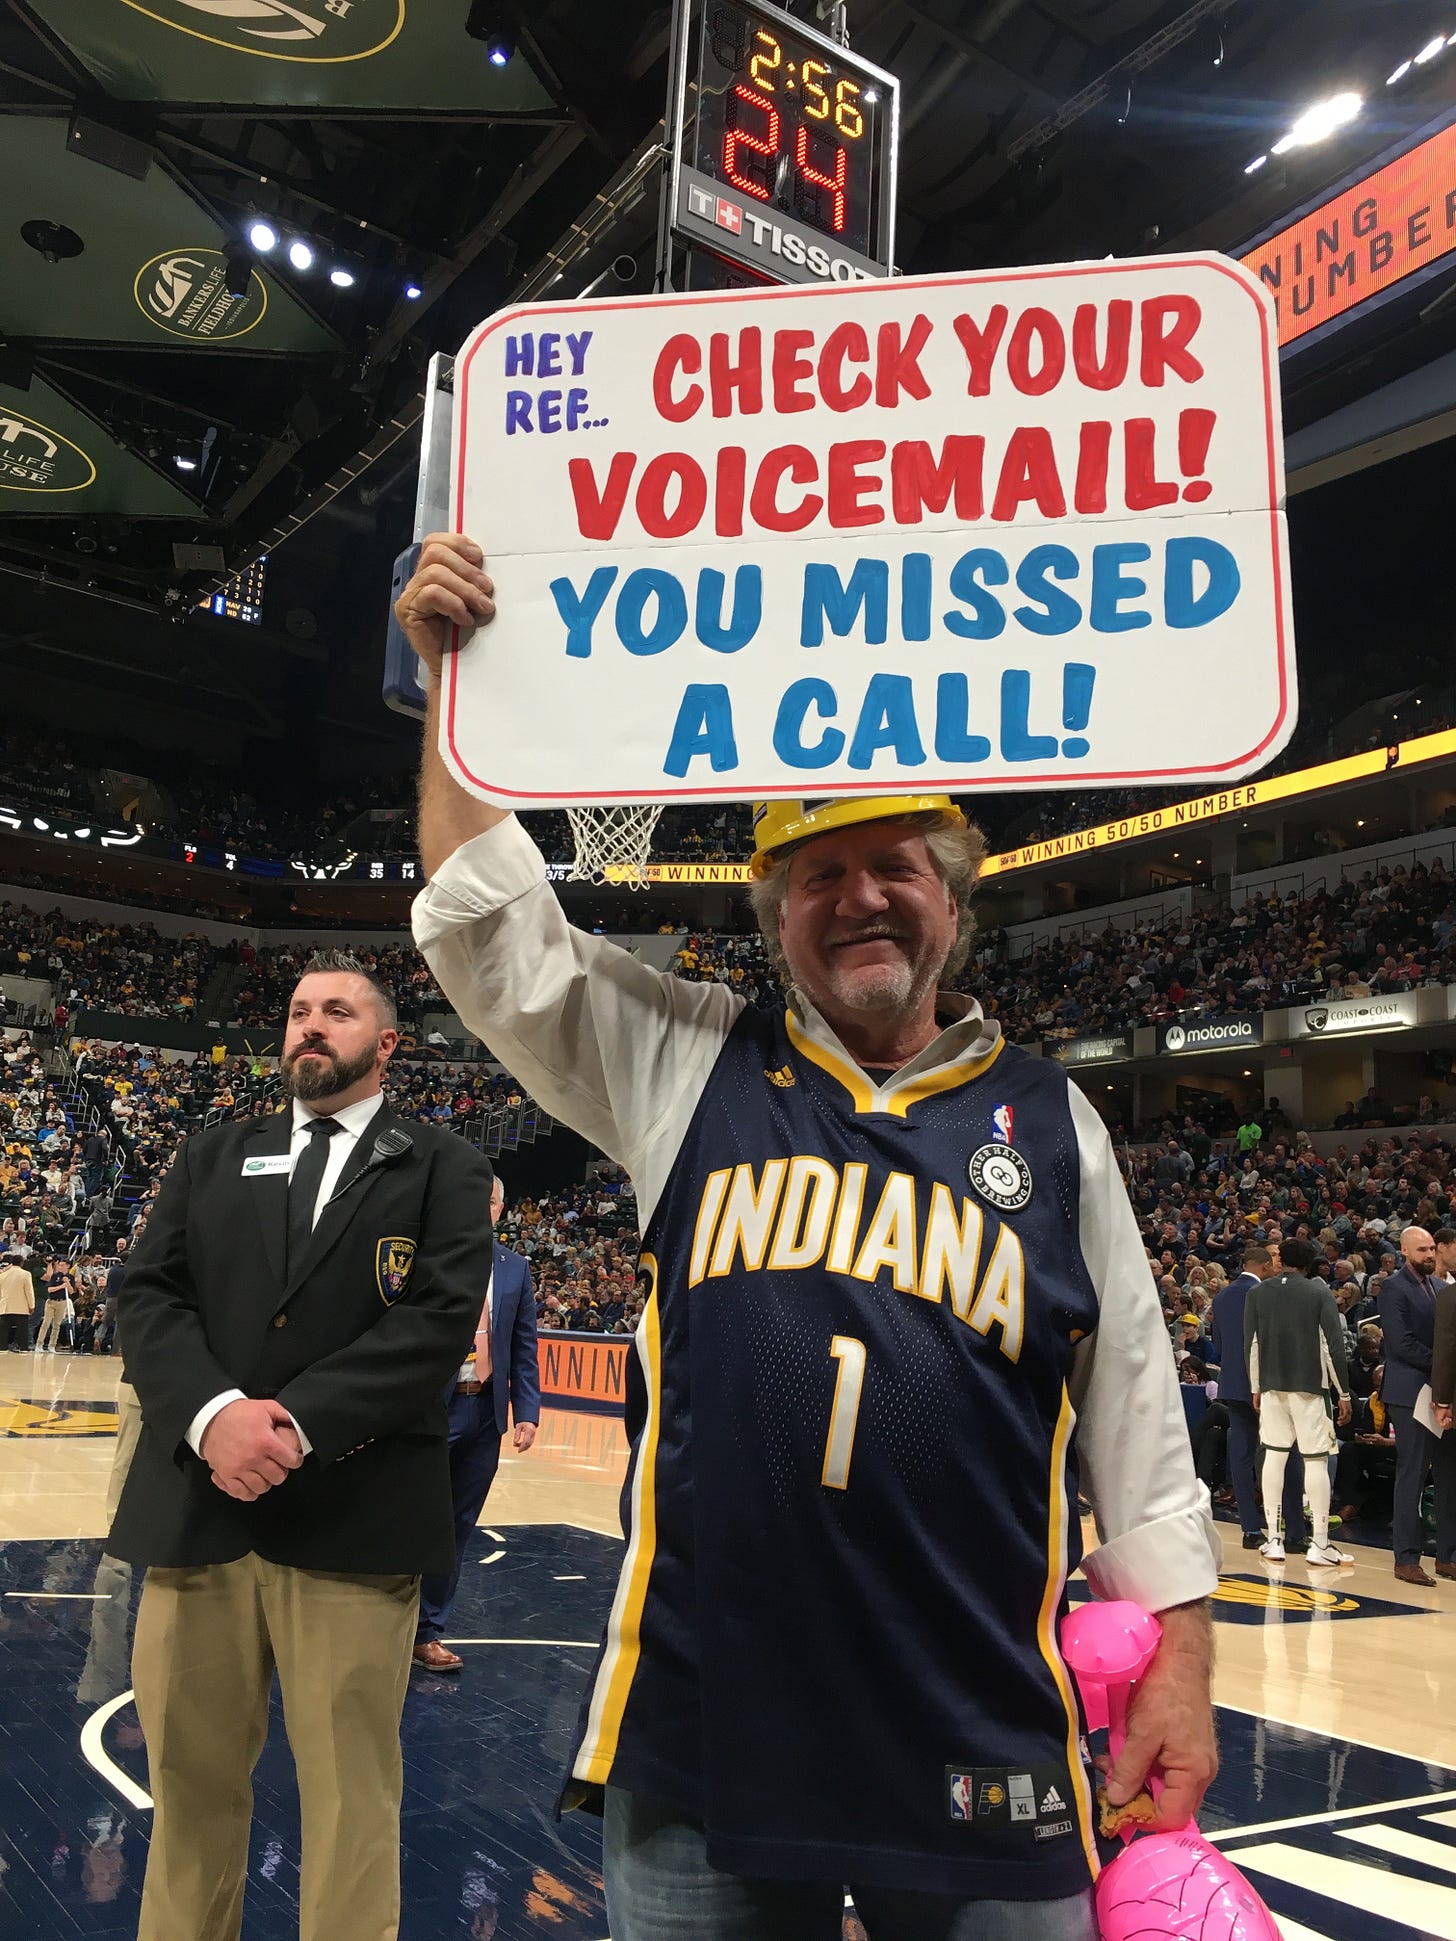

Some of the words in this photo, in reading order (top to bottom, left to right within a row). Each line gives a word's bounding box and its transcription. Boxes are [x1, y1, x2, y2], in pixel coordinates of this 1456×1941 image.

[750, 31, 864, 139] 2:56
[724, 84, 847, 232] 24
[1274, 189, 1456, 328] UMBE
[198, 288, 236, 336] FIELDHO
[505, 331, 593, 379] HEY
[653, 314, 933, 424] CHECK
[953, 294, 1204, 398] YOUR
[506, 388, 610, 436] REF...
[568, 408, 1217, 542] VOICEMAIL!
[550, 565, 762, 659] YOU
[801, 537, 1241, 648] MISSED
[663, 684, 738, 778] A
[773, 663, 1096, 770] CALL!
[1022, 831, 1096, 863] WINNING
[1106, 812, 1163, 842] 50/50
[1175, 785, 1257, 823] NUMBER
[186, 852, 194, 863] 2
[226, 860, 235, 870] 4
[370, 869, 384, 879] 35
[402, 869, 415, 879] 14
[1187, 1021, 1252, 1042] motorola
[688, 1154, 1026, 1365] INDIANA
[544, 1343, 624, 1396] NNIN
[821, 1334, 867, 1491] 1
[1016, 1802, 1031, 1816] XL
[1040, 1801, 1067, 1813] adidas
